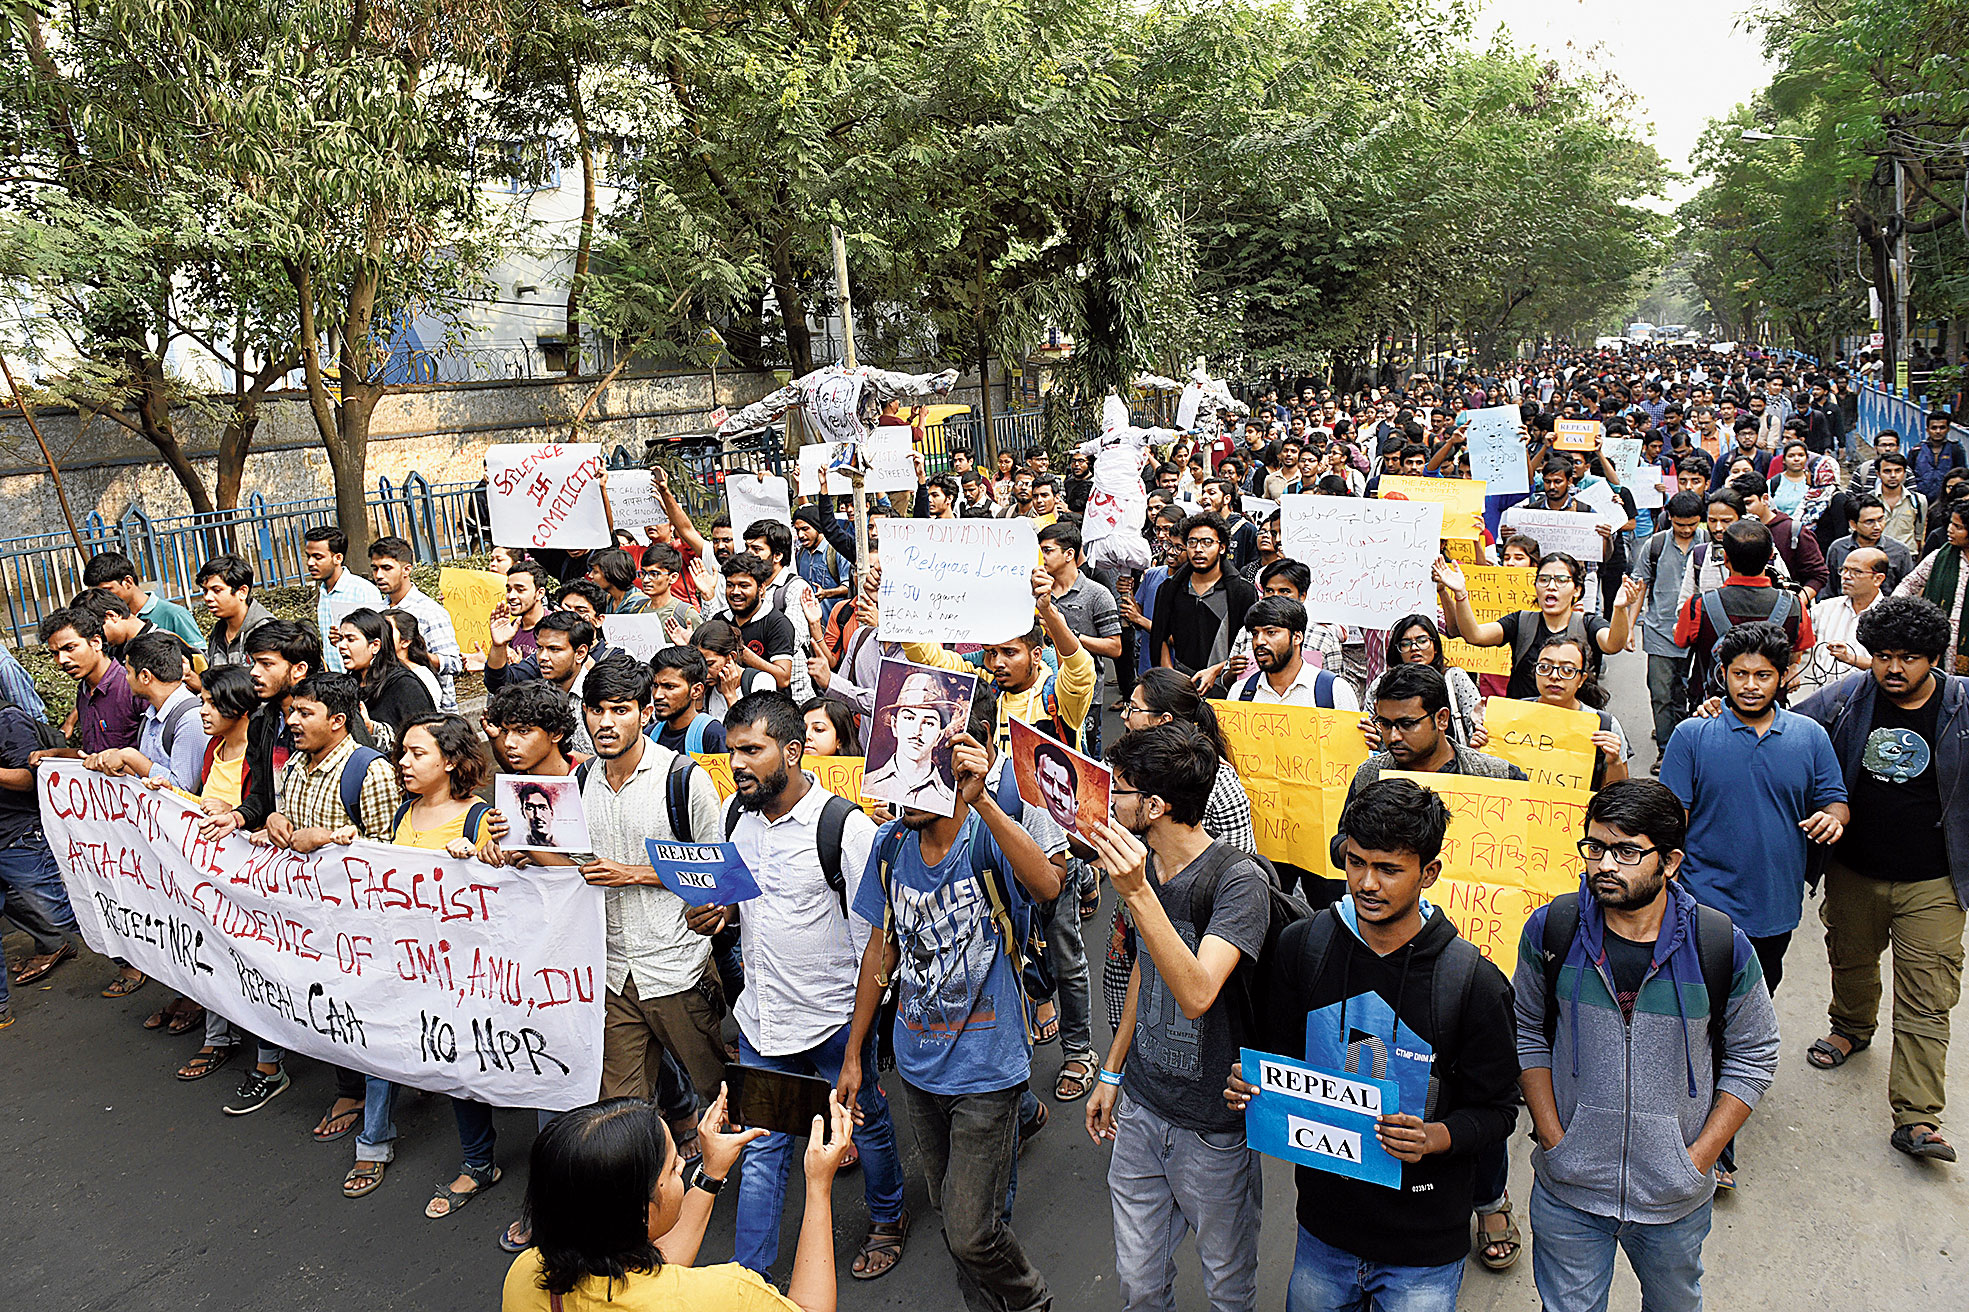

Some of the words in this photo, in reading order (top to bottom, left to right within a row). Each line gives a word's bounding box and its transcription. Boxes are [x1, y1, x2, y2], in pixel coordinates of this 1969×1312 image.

[1560, 423, 1592, 431] REPEAL
[1565, 436, 1583, 444] CAA
[493, 442, 564, 497] SILENCE
[532, 455, 600, 548] COMPLICITY
[1519, 512, 1577, 526] CONDEMN
[883, 523, 916, 541] STOP
[927, 524, 1016, 548] DIVIDING
[469, 585, 492, 606] NO
[454, 612, 490, 636] COMM
[608, 625, 645, 647] People's
[1466, 657, 1489, 668] NRC
[1212, 702, 1291, 741] দিরামের
[1503, 731, 1554, 751] CAB
[47, 771, 169, 843] CONDEMN
[181, 810, 237, 877] THE
[230, 844, 342, 907] BRUTAL
[1264, 818, 1300, 844] NRC
[657, 844, 720, 861] REJECT
[676, 871, 714, 888] NRC
[67, 833, 156, 891] ATTACK
[159, 862, 188, 907] ON
[191, 881, 323, 962] STUDENTS
[336, 932, 373, 977] OF
[1449, 882, 1505, 915] NRC
[1449, 915, 1504, 945] NPR
[95, 890, 165, 950] REJECT
[168, 914, 214, 977] NRC
[228, 946, 308, 1028] REPEAL
[307, 981, 368, 1049] CAA
[419, 1010, 458, 1064] NO
[471, 1016, 570, 1077] NPR
[1264, 1065, 1379, 1111] REPEAL
[1294, 1127, 1356, 1160] CAA
